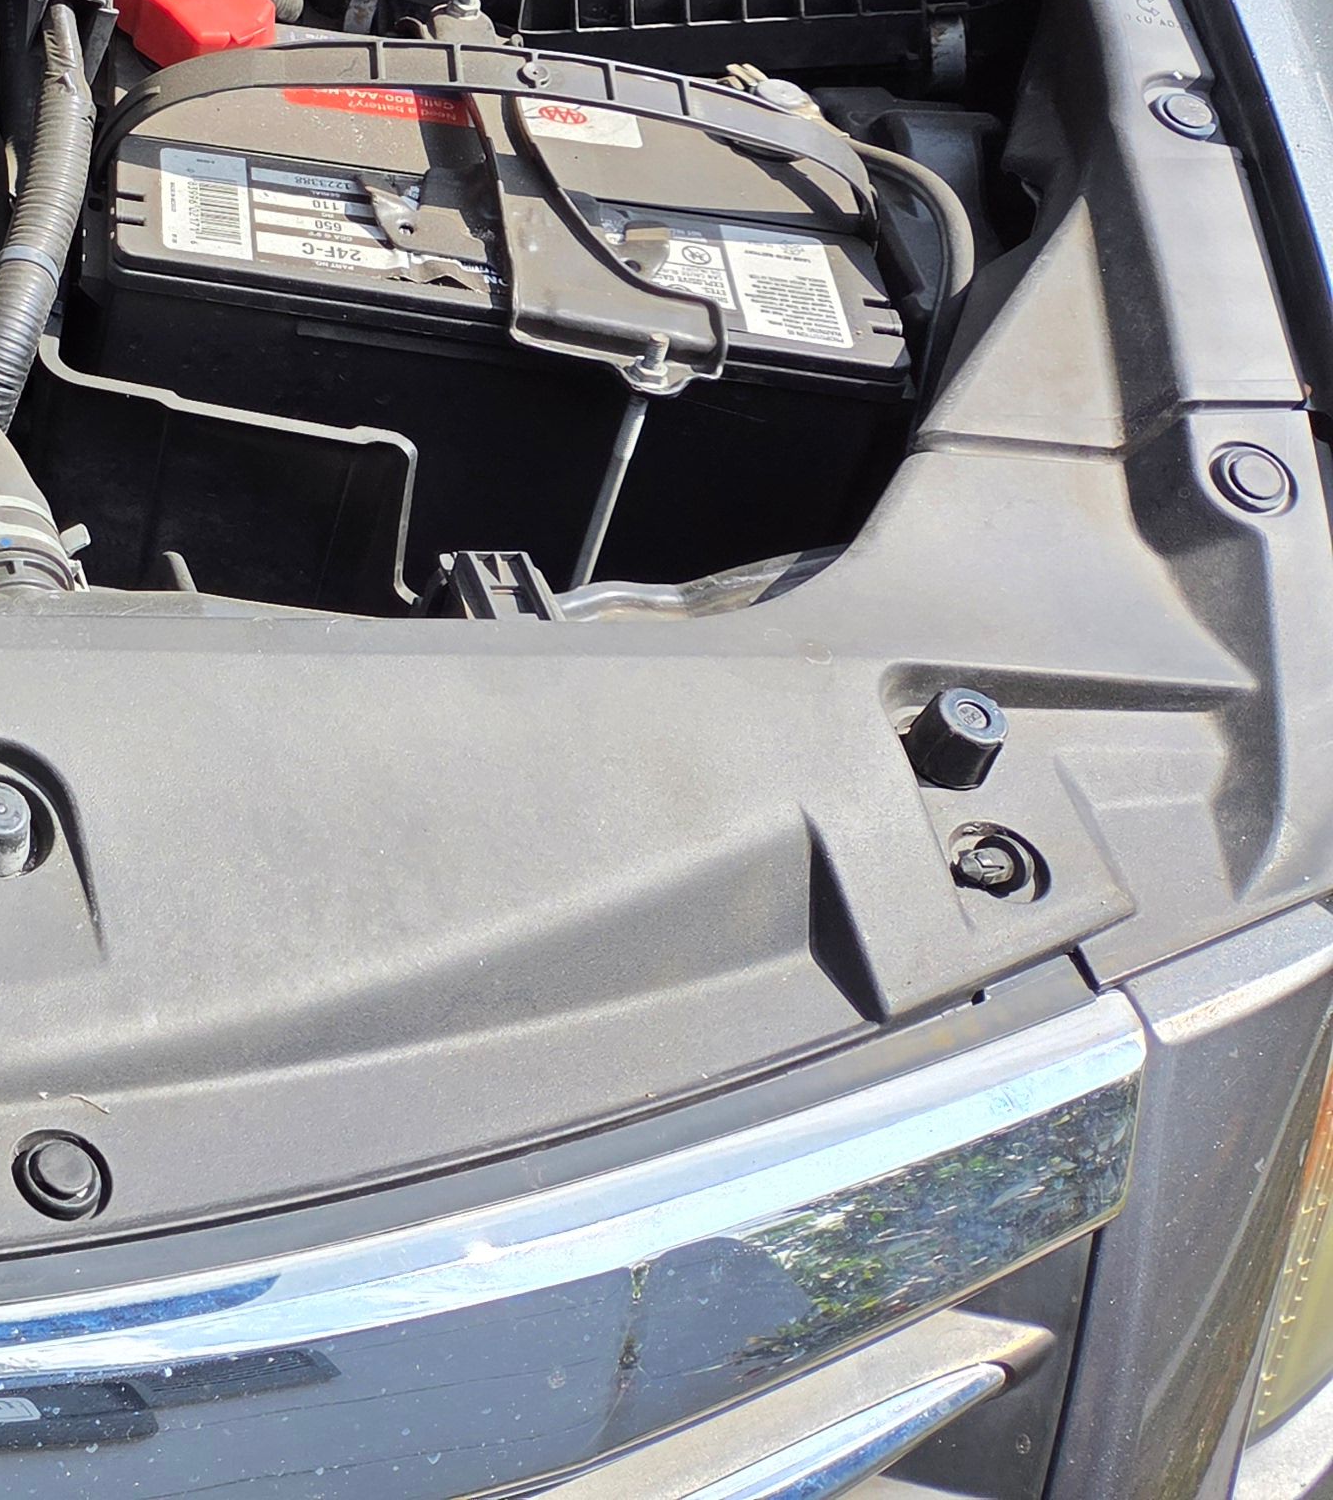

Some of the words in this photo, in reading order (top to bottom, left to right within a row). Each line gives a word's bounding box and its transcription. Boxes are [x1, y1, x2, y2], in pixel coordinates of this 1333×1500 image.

[348, 100, 406, 113] battery?
[419, 98, 454, 110] Call:
[421, 108, 457, 121] Need
[541, 106, 585, 124] AAA
[312, 199, 340, 211] 110
[314, 219, 342, 232] 650
[301, 241, 362, 262] 24F-C
